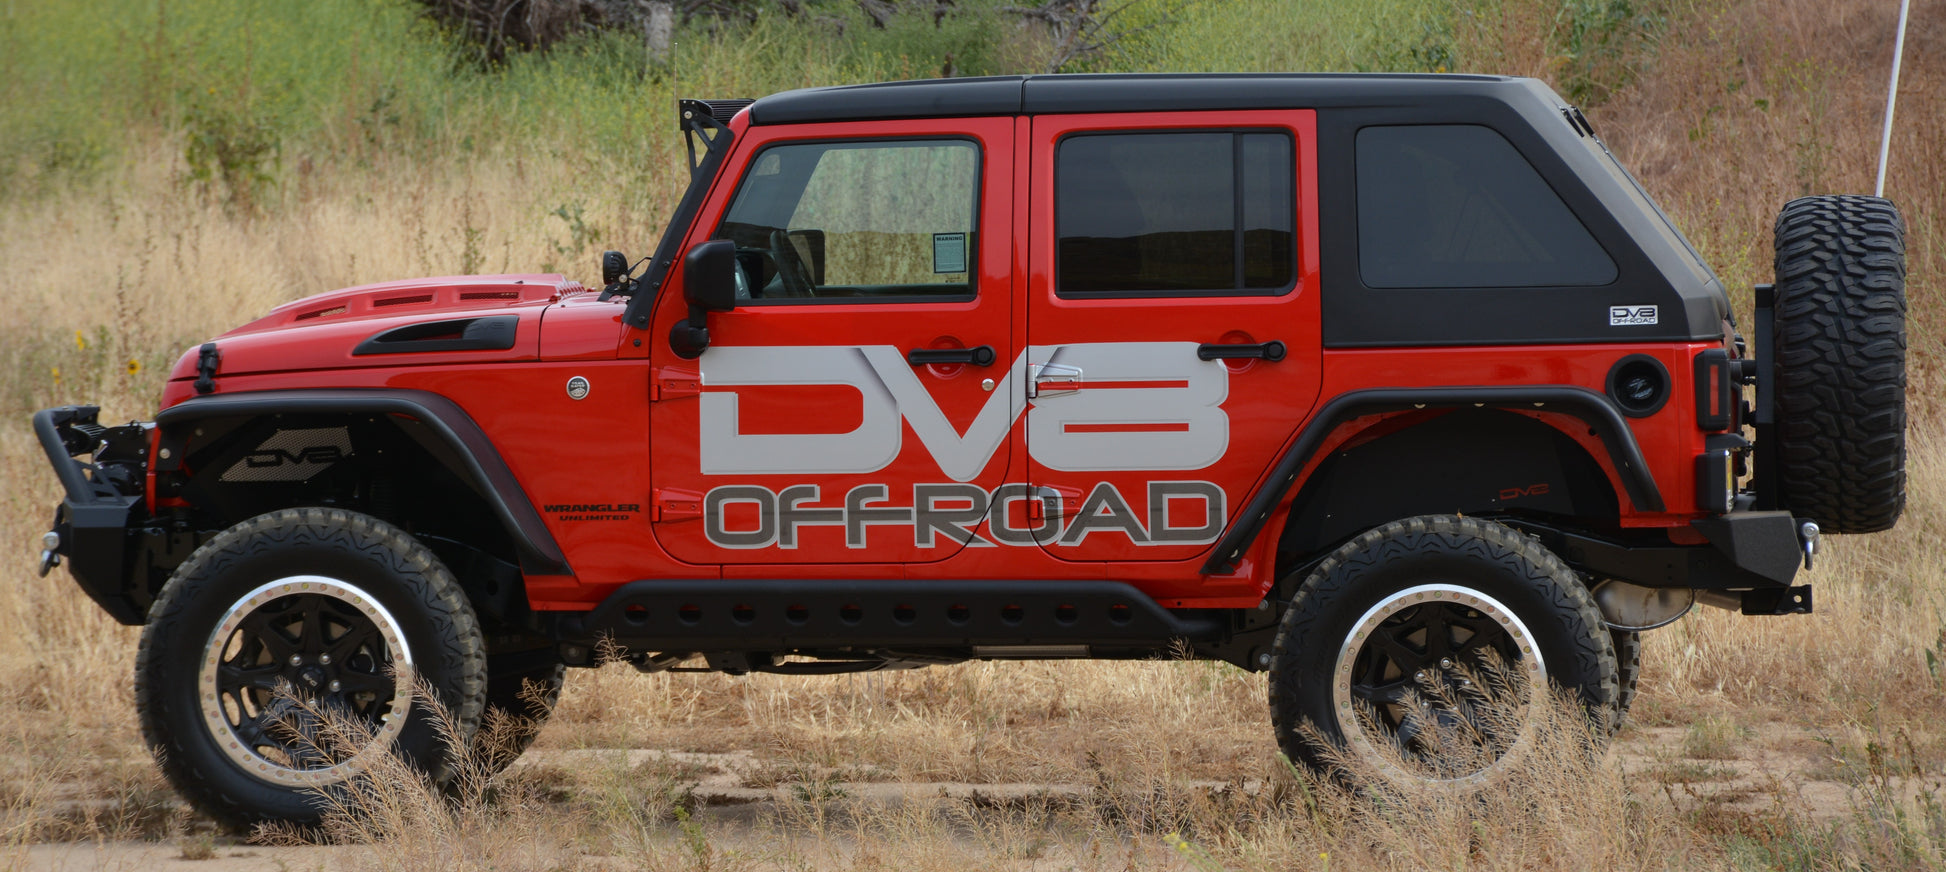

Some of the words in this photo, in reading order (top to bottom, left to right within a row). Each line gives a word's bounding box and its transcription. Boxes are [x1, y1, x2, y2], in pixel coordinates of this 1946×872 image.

[1612, 307, 1655, 318] DV8
[699, 341, 1230, 482] DV8
[246, 446, 342, 468] DV8
[1499, 484, 1549, 500] DV8
[543, 504, 640, 513] WRANGLER
[703, 480, 1229, 549] OFFROAD
